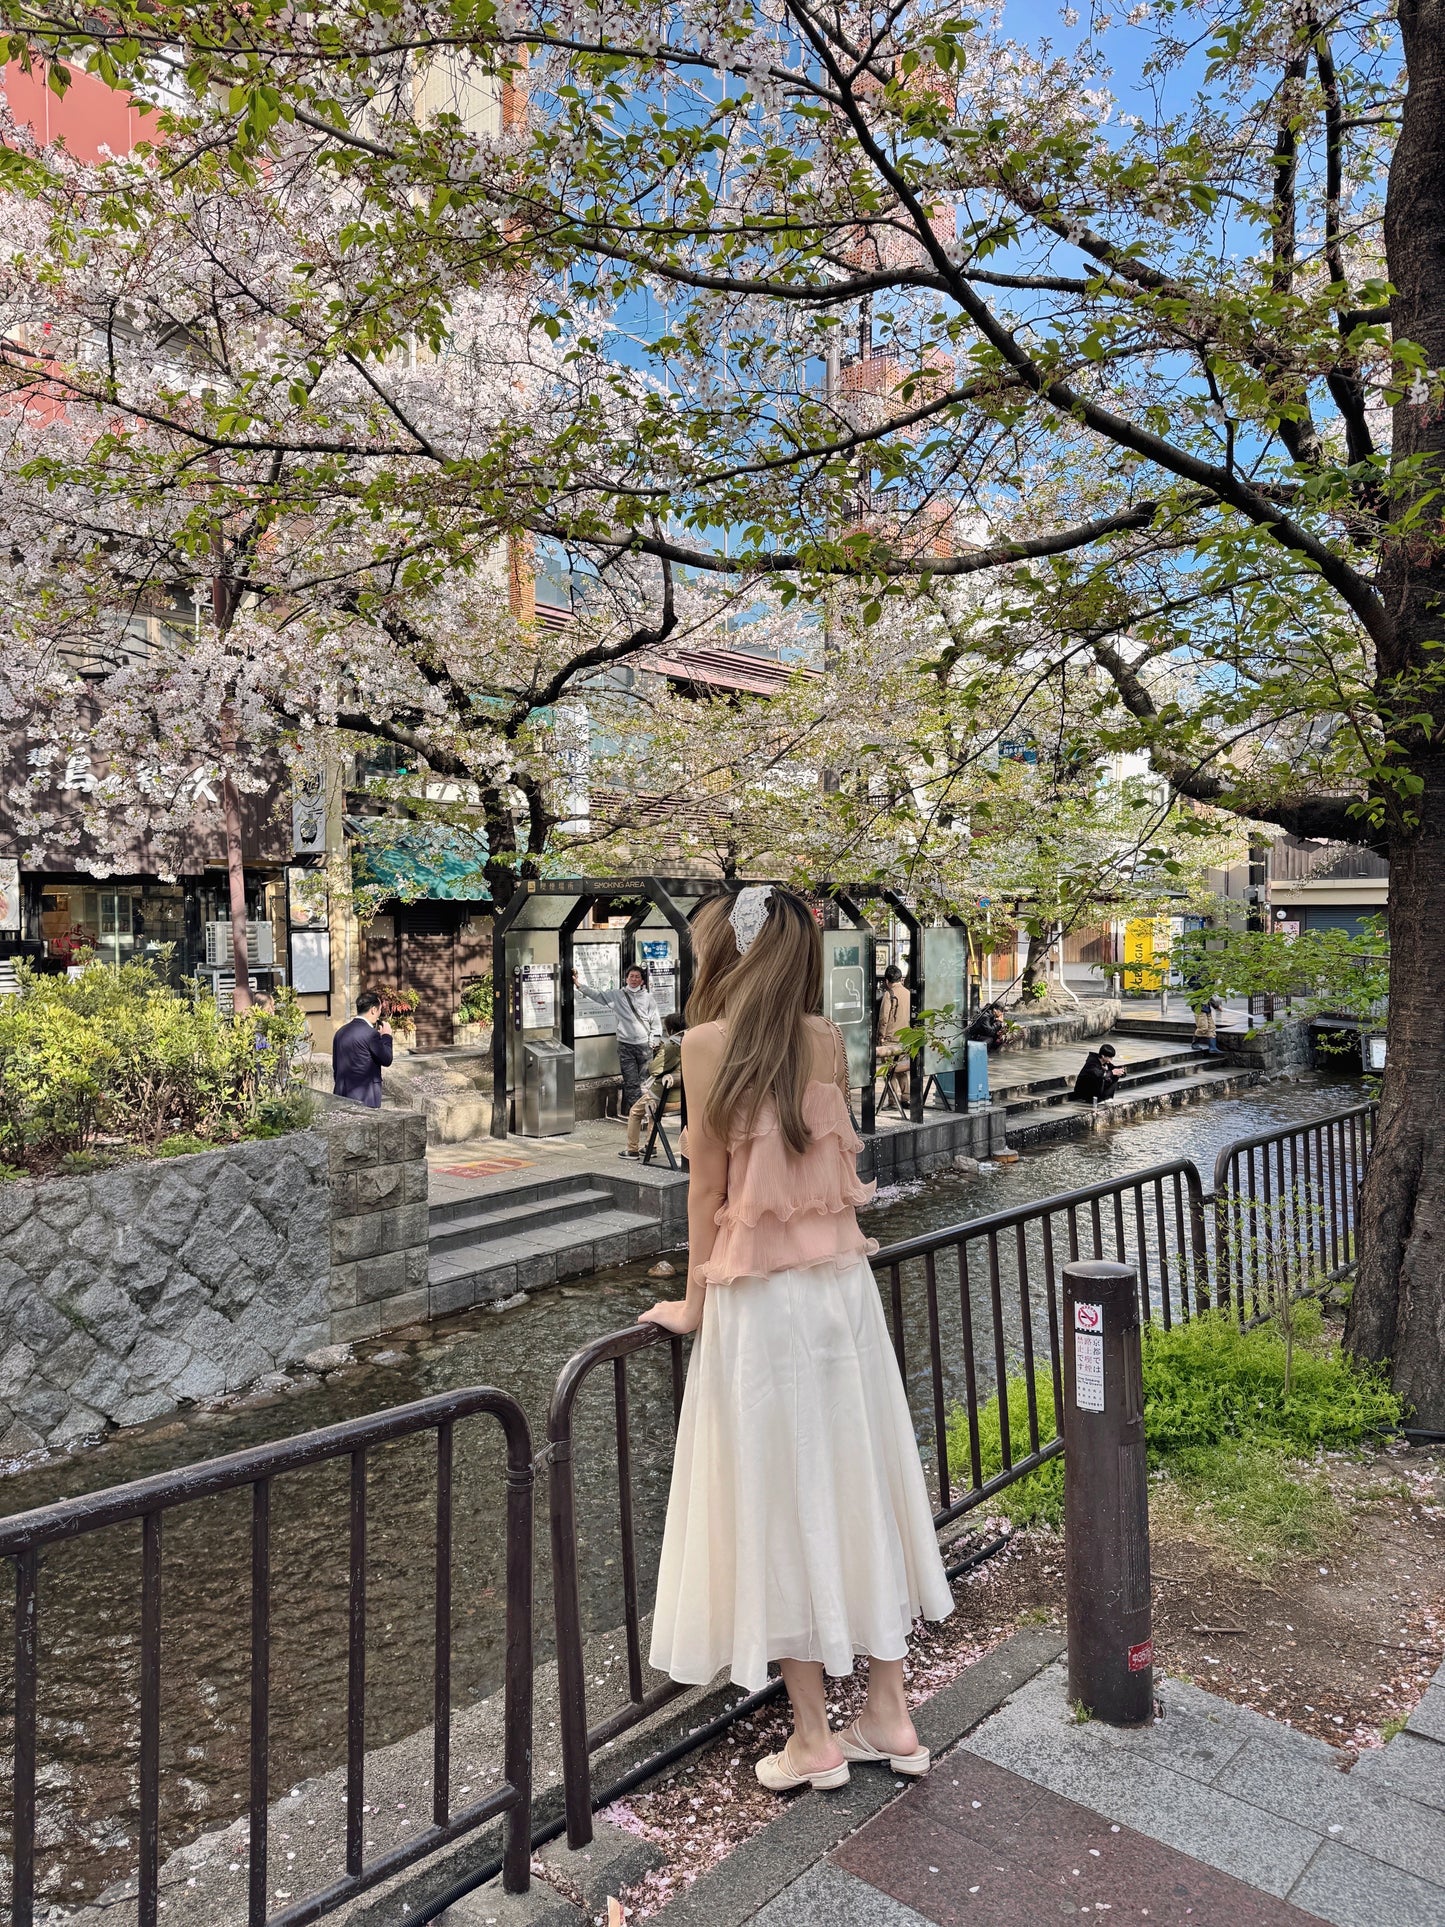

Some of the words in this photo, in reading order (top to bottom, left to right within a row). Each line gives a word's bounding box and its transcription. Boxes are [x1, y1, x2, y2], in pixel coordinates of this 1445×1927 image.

[593, 881, 624, 889] SMOKING
[1134, 943, 1143, 985] GERGIA
[1093, 1338, 1101, 1373] 京都では
